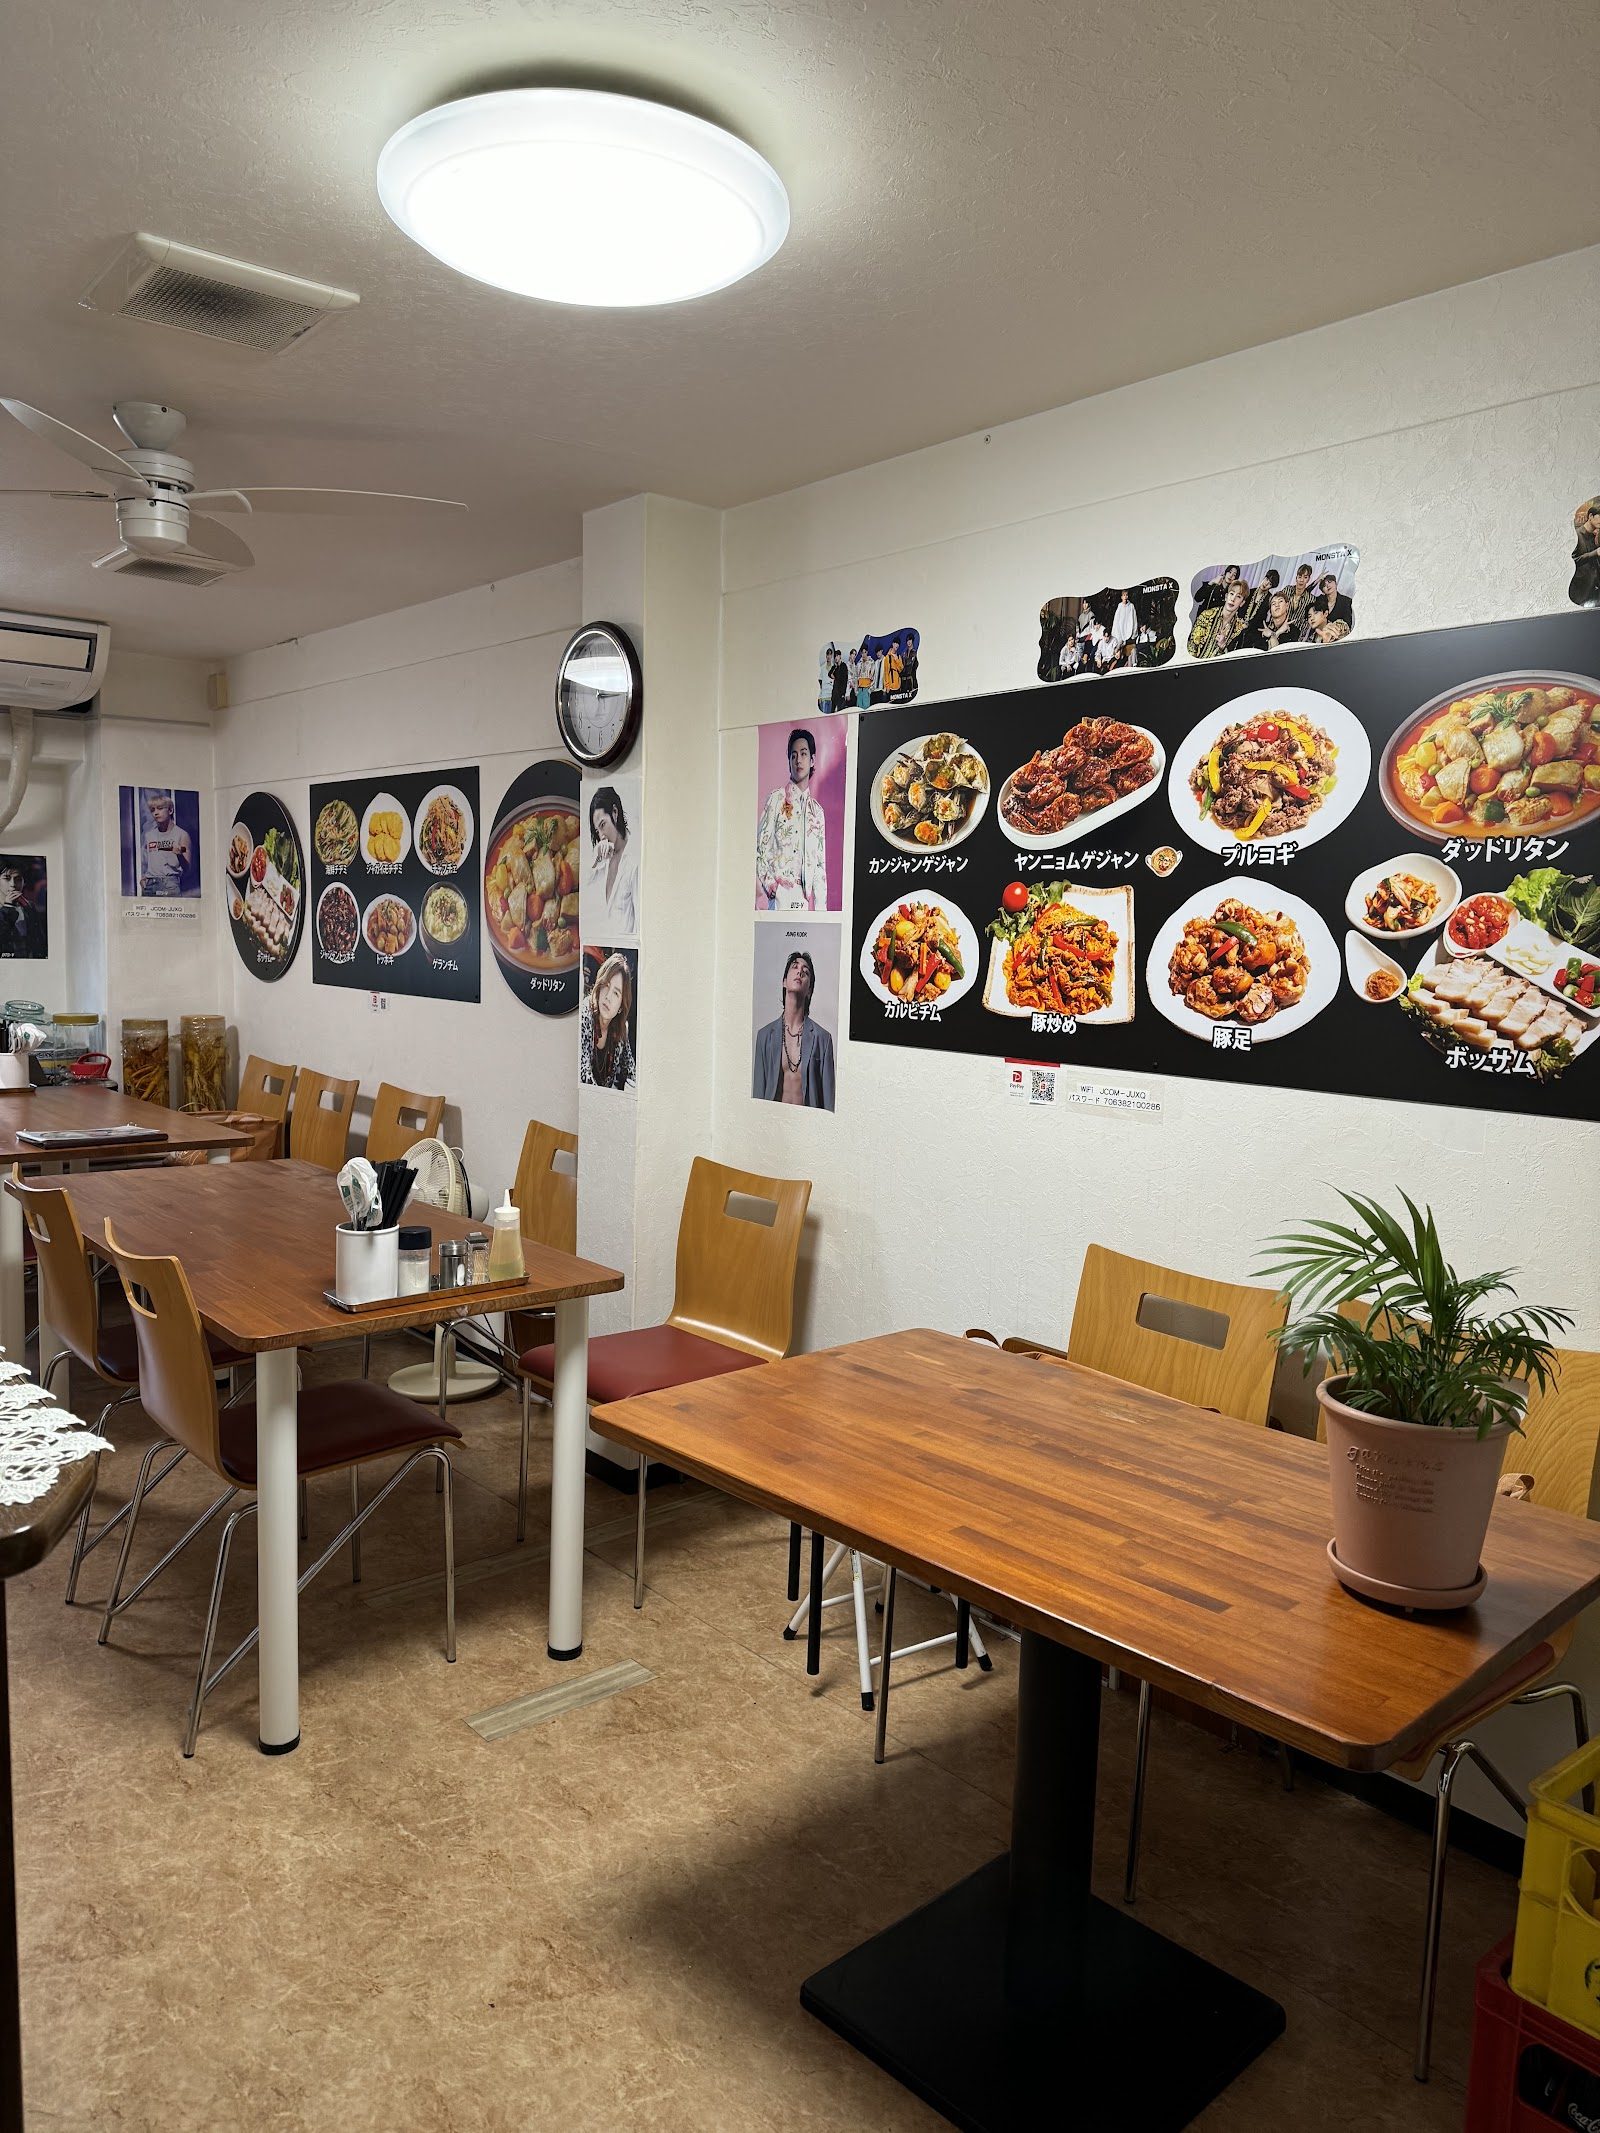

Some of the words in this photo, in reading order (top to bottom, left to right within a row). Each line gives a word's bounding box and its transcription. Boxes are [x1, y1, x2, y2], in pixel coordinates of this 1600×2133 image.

[1347, 549, 1353, 557] X
[1142, 584, 1168, 595] MONSTA
[1168, 581, 1174, 590] X
[1221, 841, 1299, 867] プルコギ
[1440, 837, 1570, 863] ダッドリタン
[868, 856, 969, 875] カンジャンゲジャン
[1014, 850, 1139, 872] ヤンニョムゲジャン
[432, 958, 459, 971] ゲランチム
[530, 976, 566, 992] ダッドリタン
[884, 1001, 942, 1022] カルビチム
[1031, 1013, 1077, 1035] 豚炒め
[1212, 1027, 1252, 1051] 豚足
[1445, 1045, 1536, 1076] ボッサム
[1068, 1094, 1100, 1104] パスワード
[1104, 1098, 1161, 1110] 706382100286
